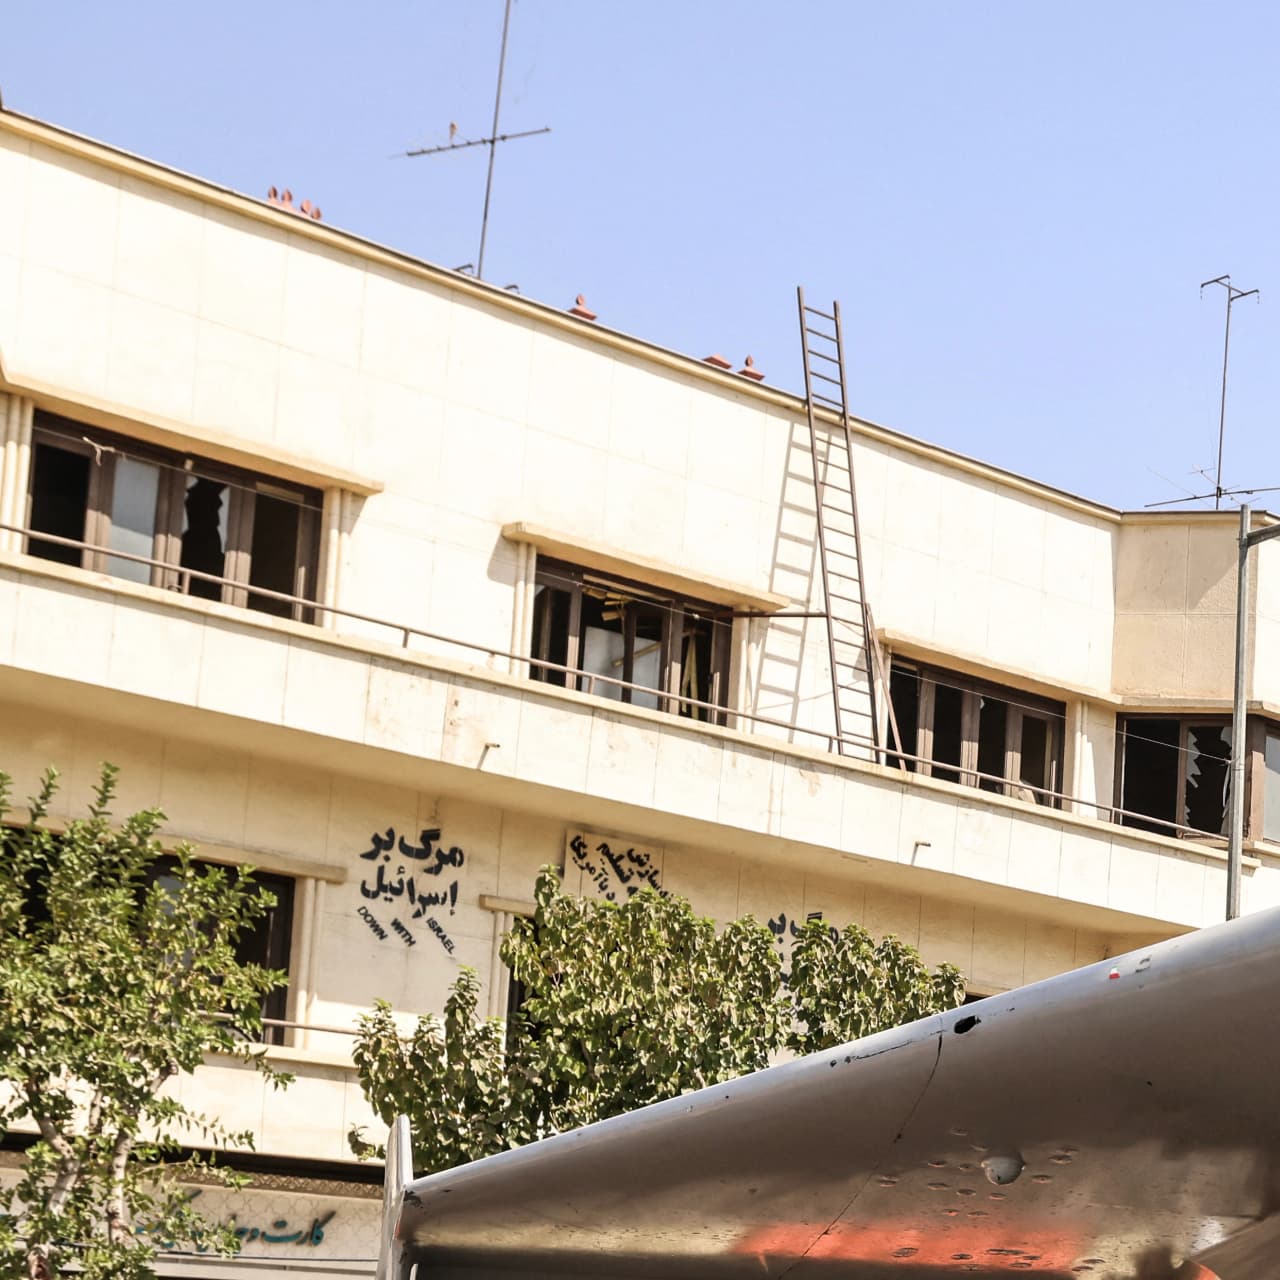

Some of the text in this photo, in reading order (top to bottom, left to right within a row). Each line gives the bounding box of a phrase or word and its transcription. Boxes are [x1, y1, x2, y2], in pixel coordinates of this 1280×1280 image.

[360, 827, 464, 876] مرگ بر
[357, 906, 455, 955] DOWN WITH ISRAEL
[260, 1211, 337, 1246] کارت
